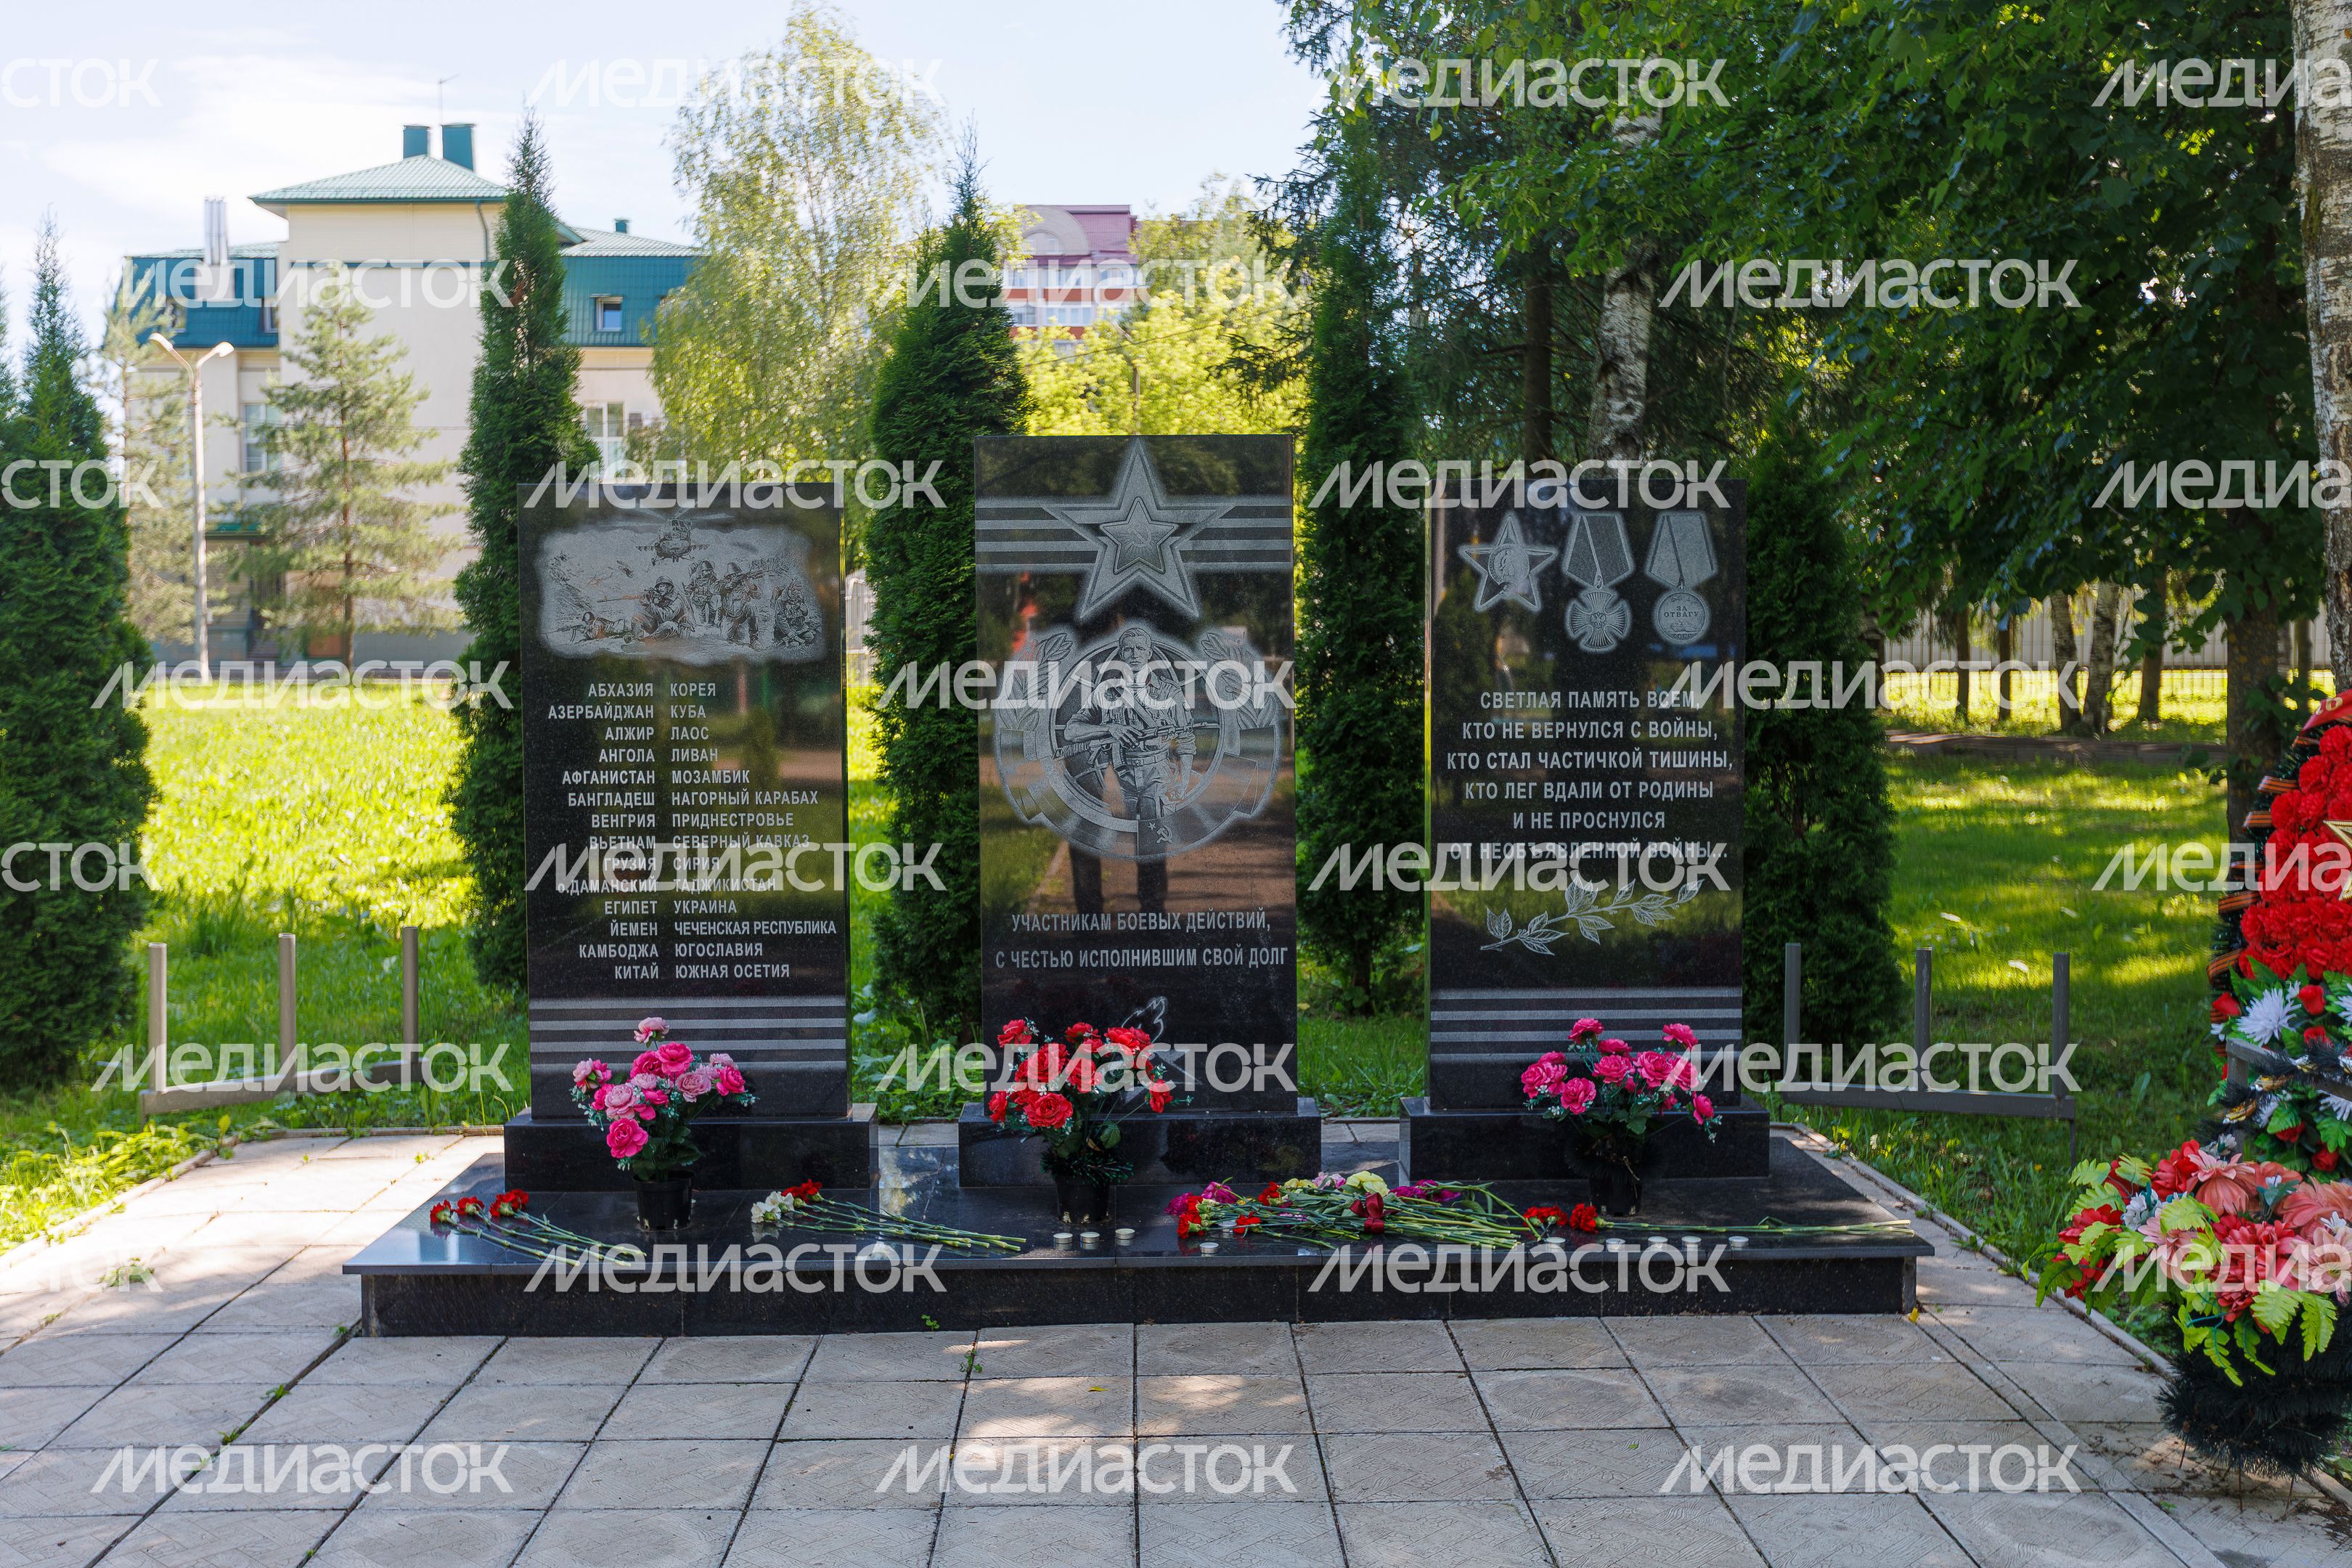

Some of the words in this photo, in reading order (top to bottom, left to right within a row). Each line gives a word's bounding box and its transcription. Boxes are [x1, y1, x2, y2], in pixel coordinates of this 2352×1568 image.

[588, 682, 653, 697] АБХАЗИЯ
[670, 682, 716, 697] КОРЕЯ
[1480, 691, 1561, 709] СВЕТЛАЯ
[1568, 690, 1640, 709] ПАМЯТЬ
[1647, 690, 1700, 711] ВСЕМ,
[548, 702, 653, 721] АЗЕРБАЙДЖАН
[670, 705, 706, 719] КУБА
[605, 727, 654, 741] АЛЖИР
[671, 727, 709, 740] ЛАОС
[1463, 722, 1495, 739] КТО
[1502, 722, 1524, 739] НЕ
[1532, 721, 1624, 739] ВЕРНУЛСЯ
[1630, 721, 1641, 738] С
[1649, 716, 1718, 740] ВОЙНЫ,
[599, 748, 655, 762] АНГОЛА
[671, 748, 718, 762] ЛИВАН
[1447, 752, 1479, 769] КТО
[1487, 752, 1531, 769] СТАЛ
[1538, 747, 1642, 769] ЧАСТИЧКОЙ
[1649, 751, 1733, 770] ТИШИНЫ,
[562, 770, 656, 785] АФГАНИСТАН
[671, 769, 750, 784] МОЗАМБИК
[671, 788, 749, 806] НАГОРНЫЙ
[755, 791, 818, 805] КАРАБАХ
[1465, 782, 1498, 799] КТО
[1504, 782, 1537, 799] ЛЕГ
[1544, 781, 1602, 802] ВДАЛИ
[1609, 781, 1633, 799] ОТ
[1639, 780, 1713, 801] РОДИНЫ
[568, 792, 655, 808] БАНГЛАДЕШ
[592, 814, 656, 828] ВЕНГРИЯ
[672, 812, 793, 829] ПРИДНЕСТРОВЬЕ
[1513, 812, 1523, 829] И
[1531, 812, 1553, 829] НЕ
[1560, 812, 1665, 828] ПРОСНУЛСЯ
[589, 836, 656, 850] ВЬЕТНАМ
[672, 831, 750, 849] СЕВЕРНЫЙ
[756, 834, 809, 848] КАВКАЗ
[1450, 842, 1472, 859] ОТ
[1480, 838, 1640, 859] НЕОБЪЯВЛЕННОЙ
[604, 857, 656, 871] ГРУЗИЯ
[673, 857, 720, 870] СИРИЯ
[674, 878, 776, 894] ТАДЖИКИСТАН
[605, 900, 658, 915] ЕГИПЕТ
[674, 899, 737, 914] УКРАИНА
[611, 919, 658, 936] ЙЕМЕН
[674, 921, 749, 936] ЧЕЧЕНСКАЯ
[754, 920, 836, 935] РЕСПУБЛИКА
[1012, 913, 1111, 933] УЧАСТНИКАМ
[1118, 912, 1181, 930] БОЕВЫХ
[1186, 907, 1270, 933] ДЕЙСТВИЙ,
[579, 944, 659, 960] КАМБОДЖА
[675, 943, 763, 957] ЮГОСЛАВИЯ
[996, 951, 1005, 969] С
[1011, 950, 1073, 968] ЧЕСТЬЮ
[1079, 949, 1197, 968] ИСПОЛНИВШИМ
[1203, 944, 1243, 966] СВОЙ
[1249, 947, 1288, 968] ДОЛГ
[615, 963, 659, 980] КИТАЙ
[675, 965, 728, 979] ЮЖНАЯ
[734, 964, 790, 978] ОСЕТИЯ
